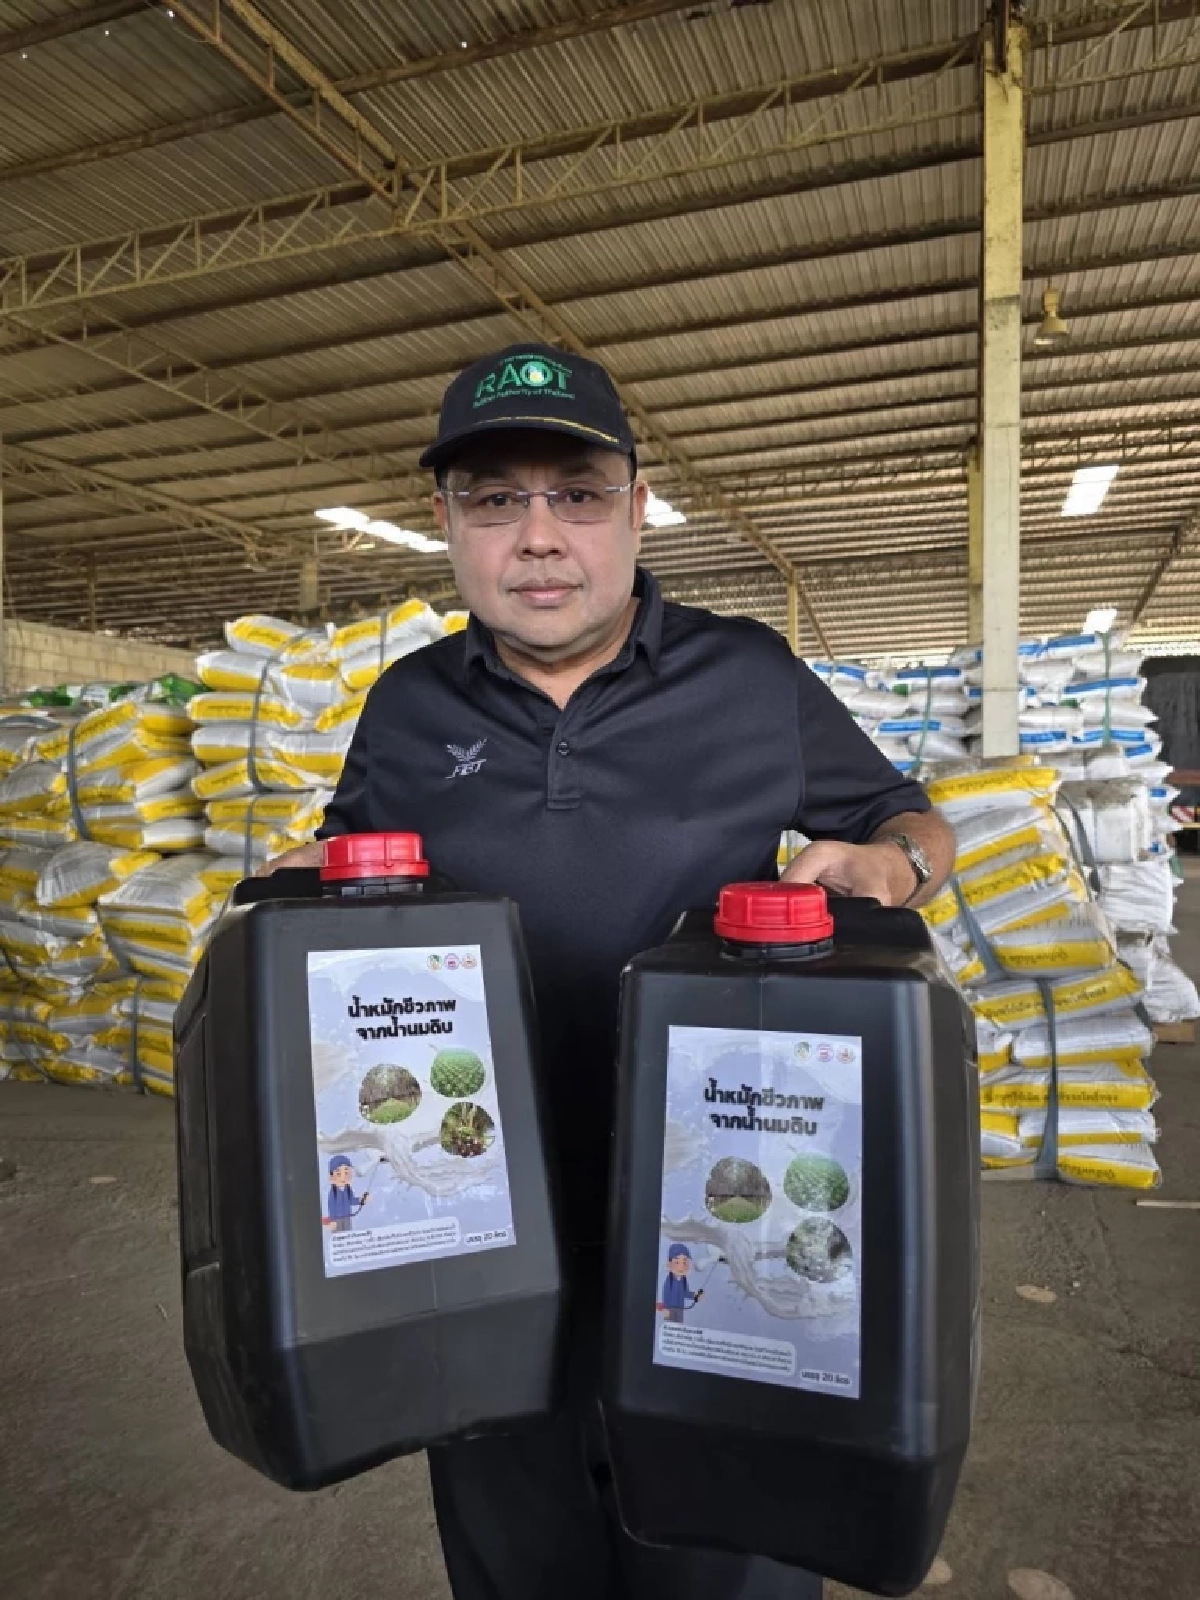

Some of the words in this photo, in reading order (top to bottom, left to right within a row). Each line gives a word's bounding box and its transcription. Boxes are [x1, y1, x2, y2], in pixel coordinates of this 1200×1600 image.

[475, 361, 572, 398] RAOT
[348, 995, 456, 1017] น้ำหมักชีวภาพ
[356, 1016, 453, 1040] จากน้ำนมดิบ
[704, 1077, 825, 1110] น้ำหมักชีวภาพ
[709, 1106, 818, 1135] จากน้ำนมดิบ
